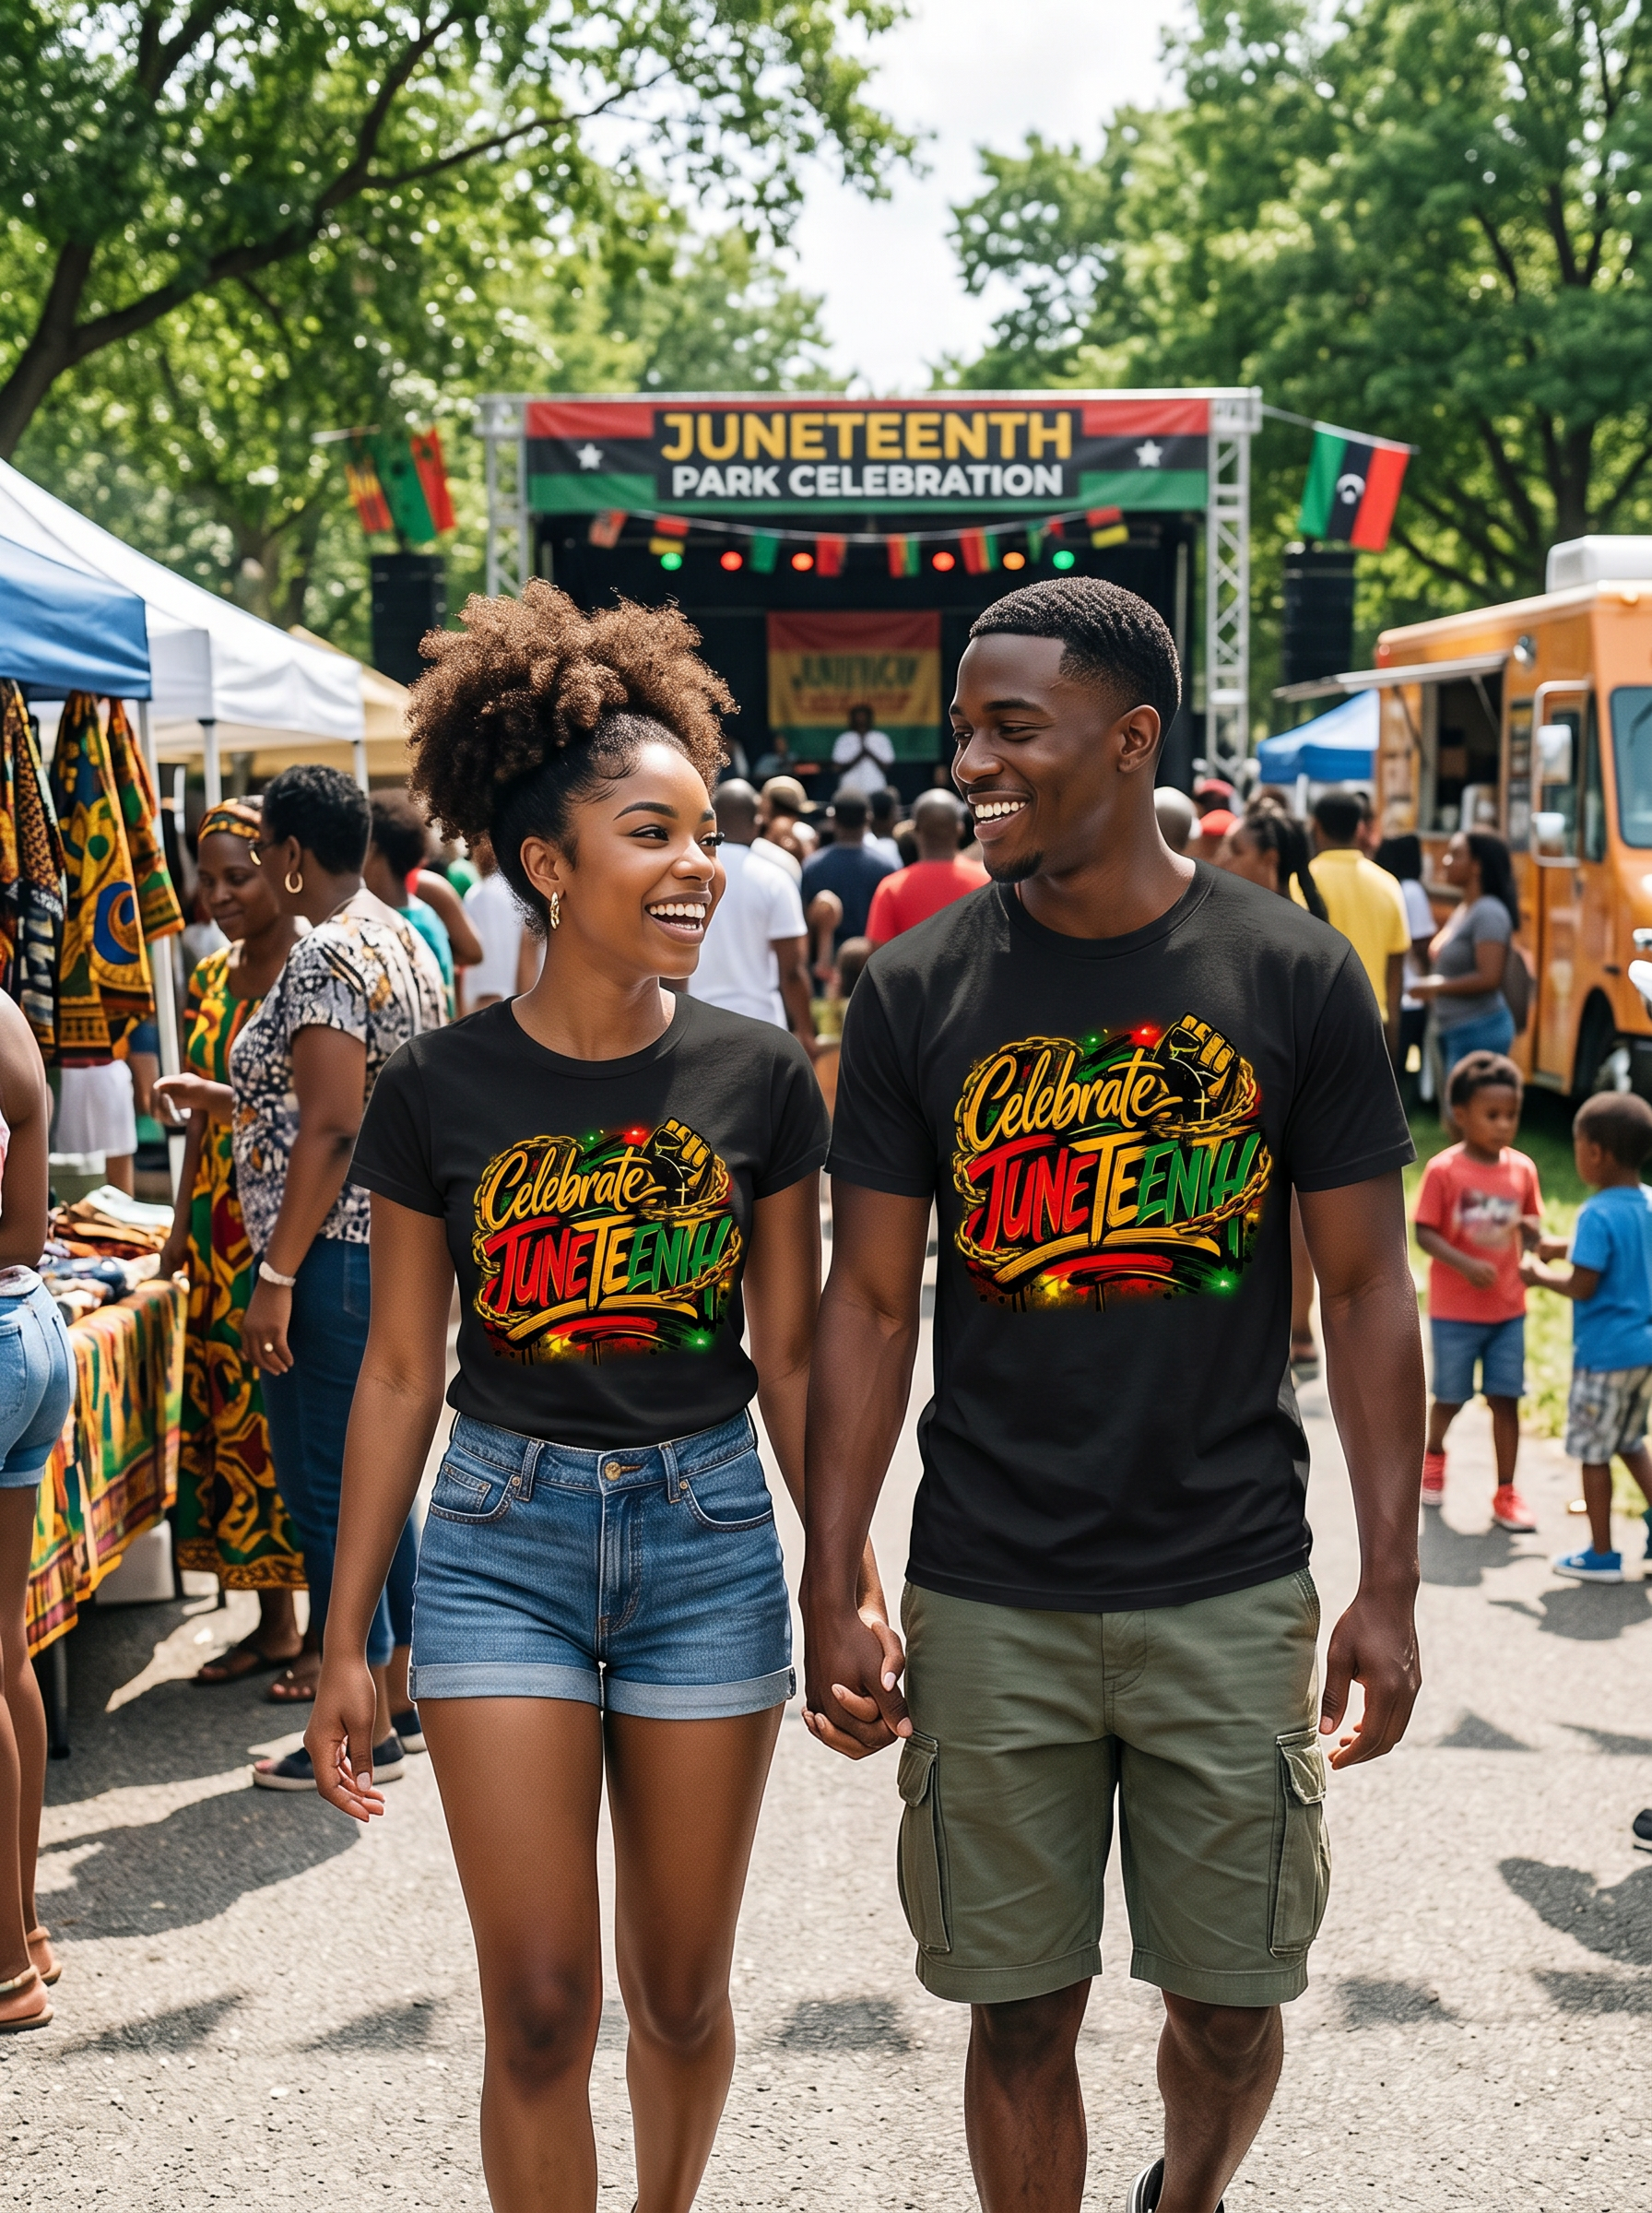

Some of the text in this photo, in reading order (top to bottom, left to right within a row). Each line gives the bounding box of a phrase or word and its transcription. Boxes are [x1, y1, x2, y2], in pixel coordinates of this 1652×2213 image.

[661, 411, 1072, 461] JUNETEENTH
[672, 465, 1063, 497] PARK CELEBRATION
[965, 1048, 1184, 1153] Celebrate
[481, 1146, 667, 1230] Celebrate
[968, 1125, 1260, 1258] JUNETEENTH
[483, 1210, 732, 1320] JUNETEENTH
